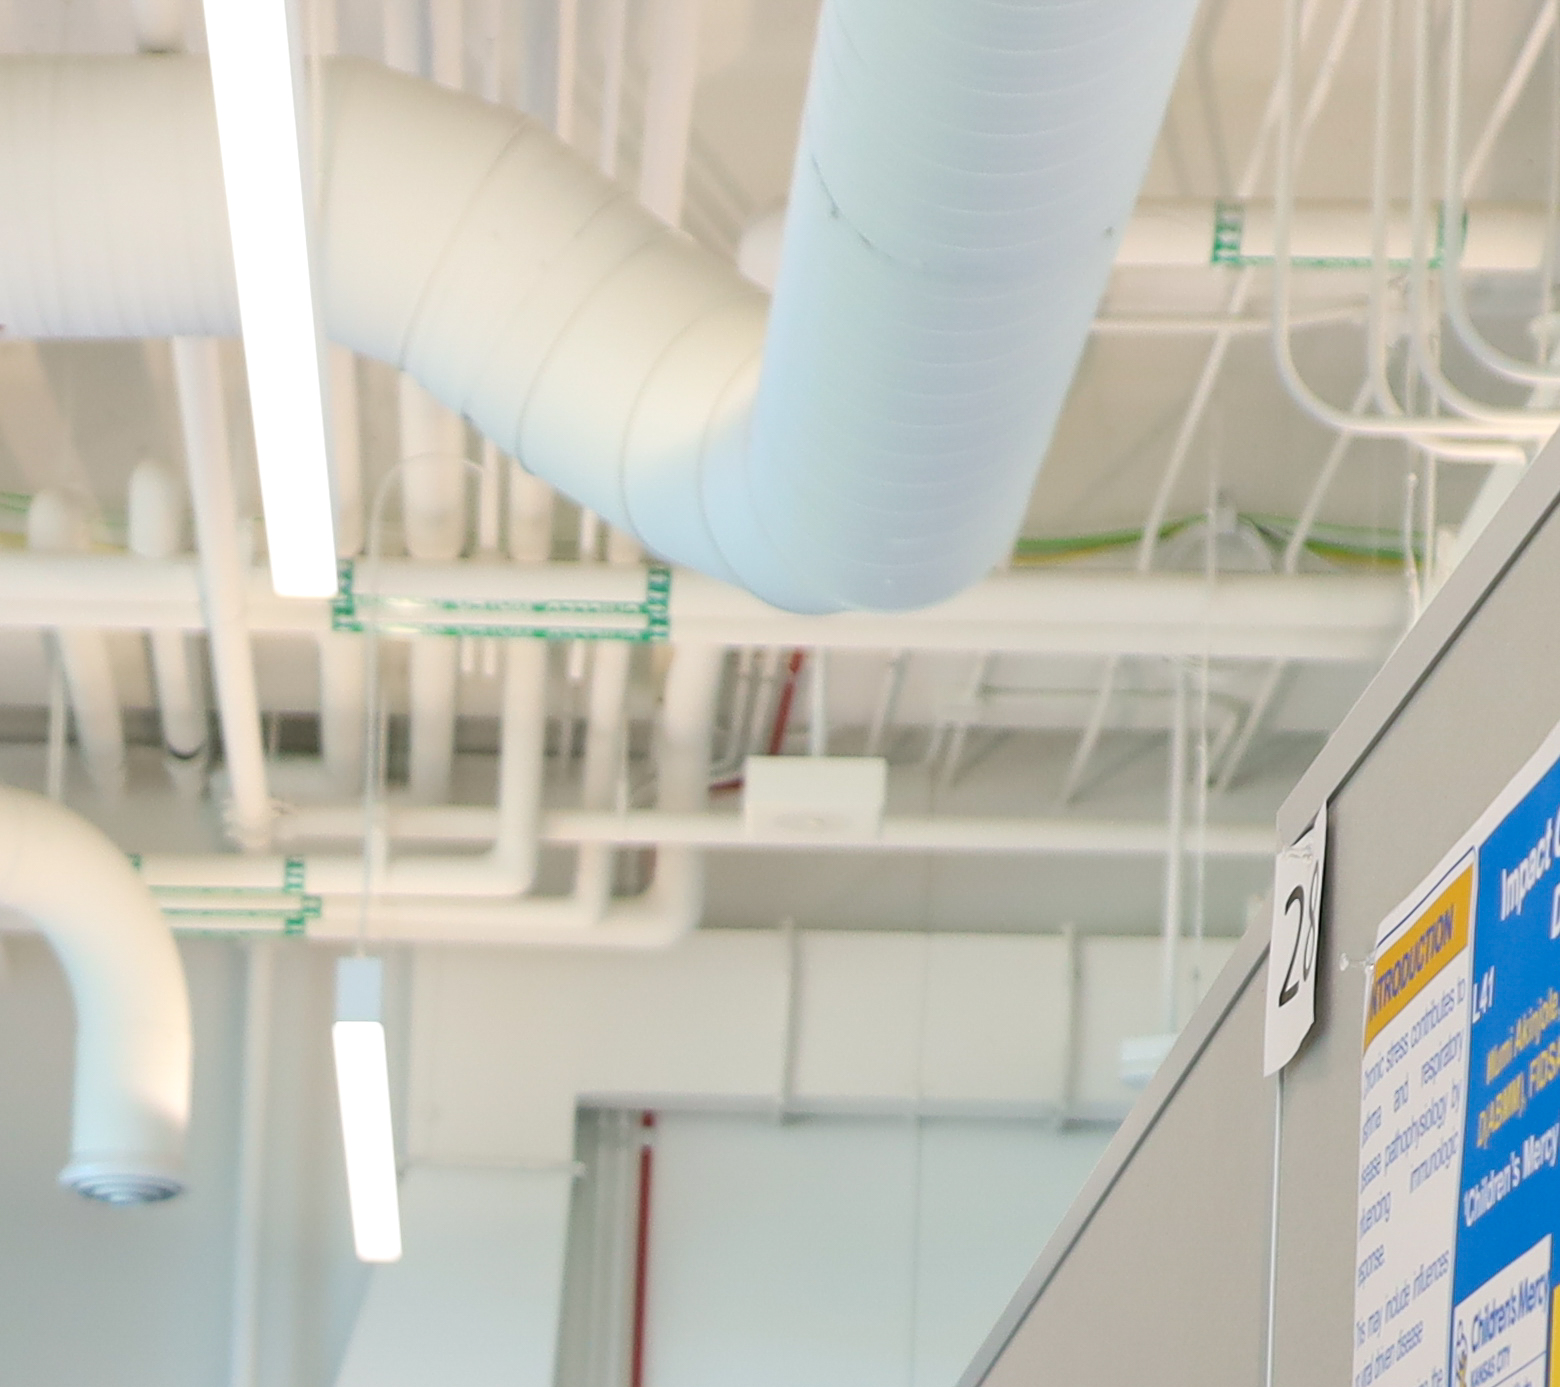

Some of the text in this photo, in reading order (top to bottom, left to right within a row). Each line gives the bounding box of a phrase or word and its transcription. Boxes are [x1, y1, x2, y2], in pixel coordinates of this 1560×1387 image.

[1499, 844, 1552, 921] Impact
[1278, 860, 1320, 1008] 28
[1521, 1114, 1560, 1180] Mercy
